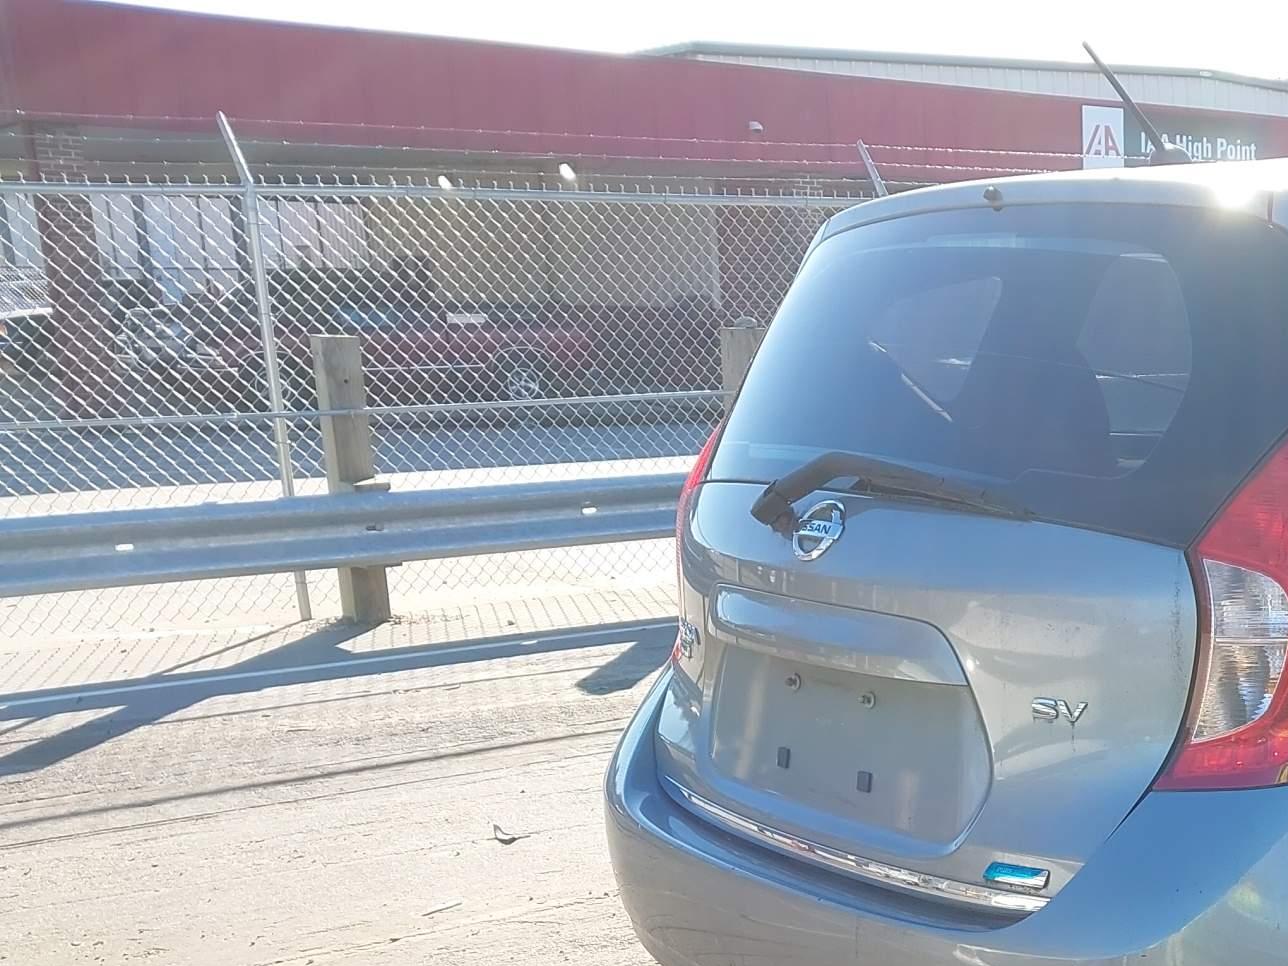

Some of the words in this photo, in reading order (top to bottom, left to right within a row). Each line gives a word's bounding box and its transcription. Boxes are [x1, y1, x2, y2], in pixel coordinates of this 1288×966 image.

[1175, 132, 1212, 161] High
[1216, 137, 1257, 161] Point
[1031, 697, 1089, 723] SV
